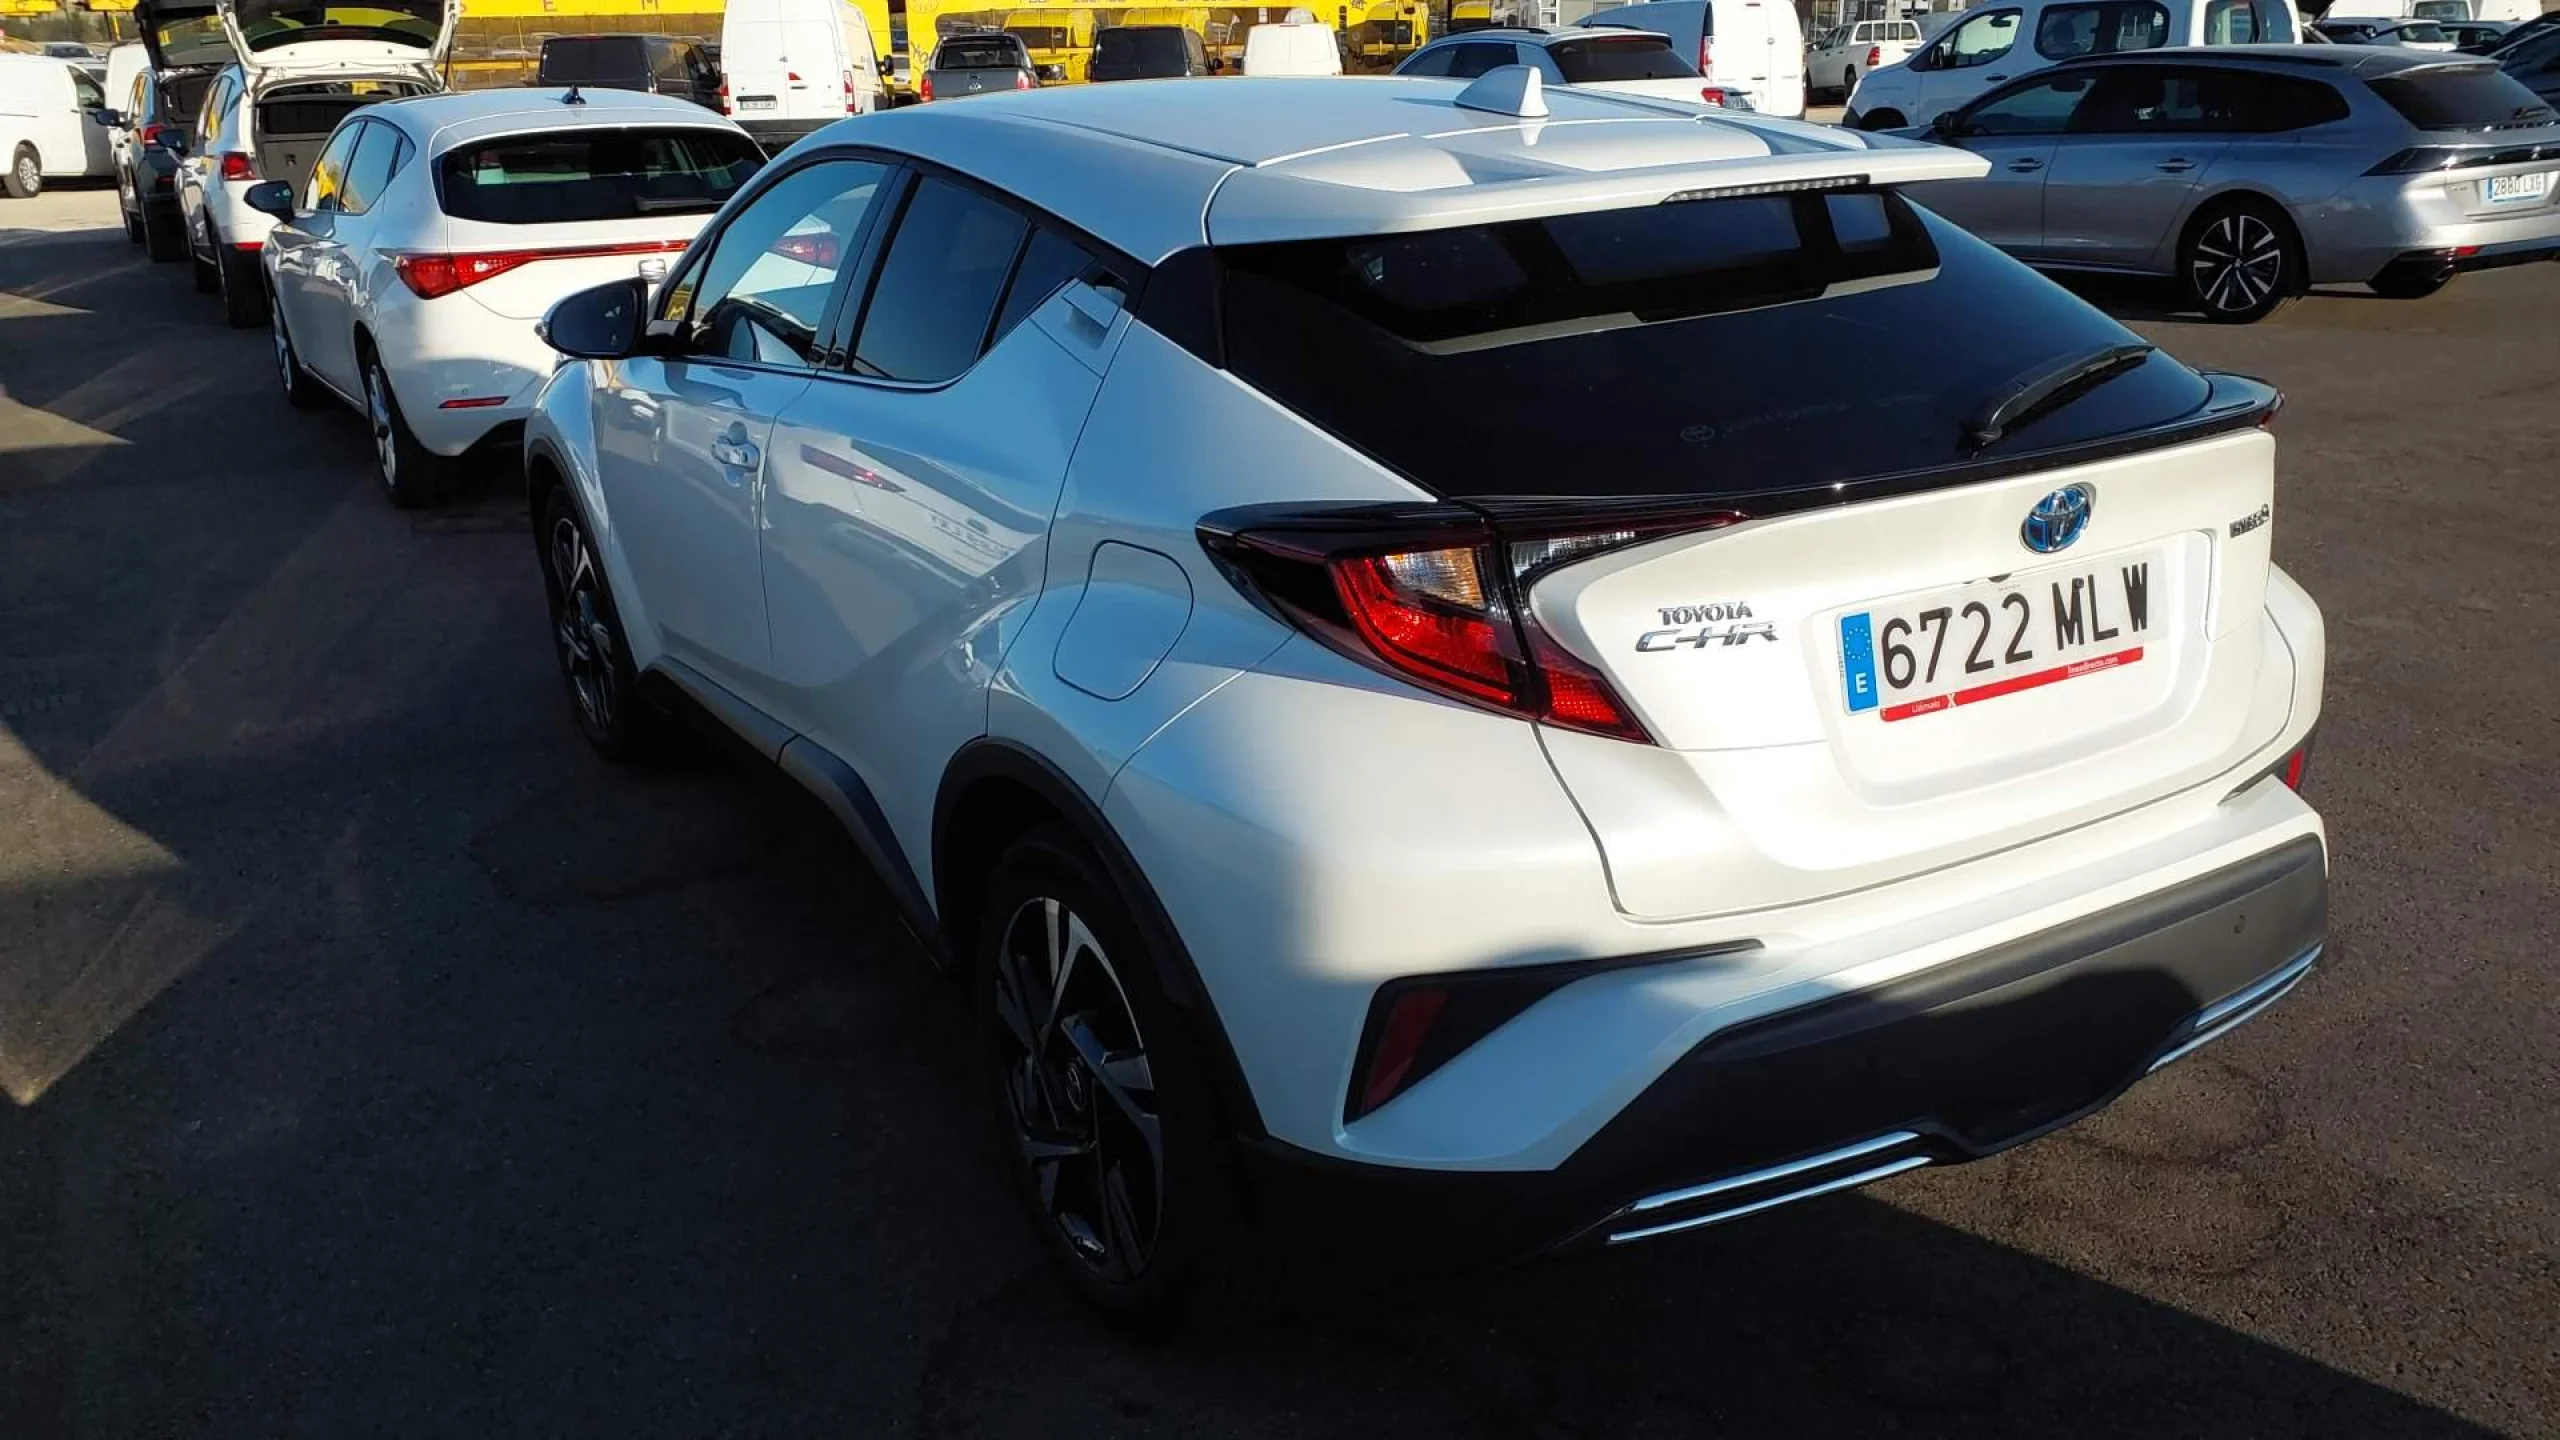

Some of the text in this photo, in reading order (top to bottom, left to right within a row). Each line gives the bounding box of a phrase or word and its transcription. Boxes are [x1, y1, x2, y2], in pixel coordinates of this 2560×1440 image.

[1658, 601, 1752, 625] TOYOTA
[1635, 621, 1779, 652] C-HR
[1881, 592, 2033, 689] 6722
[1855, 672, 1868, 694] E
